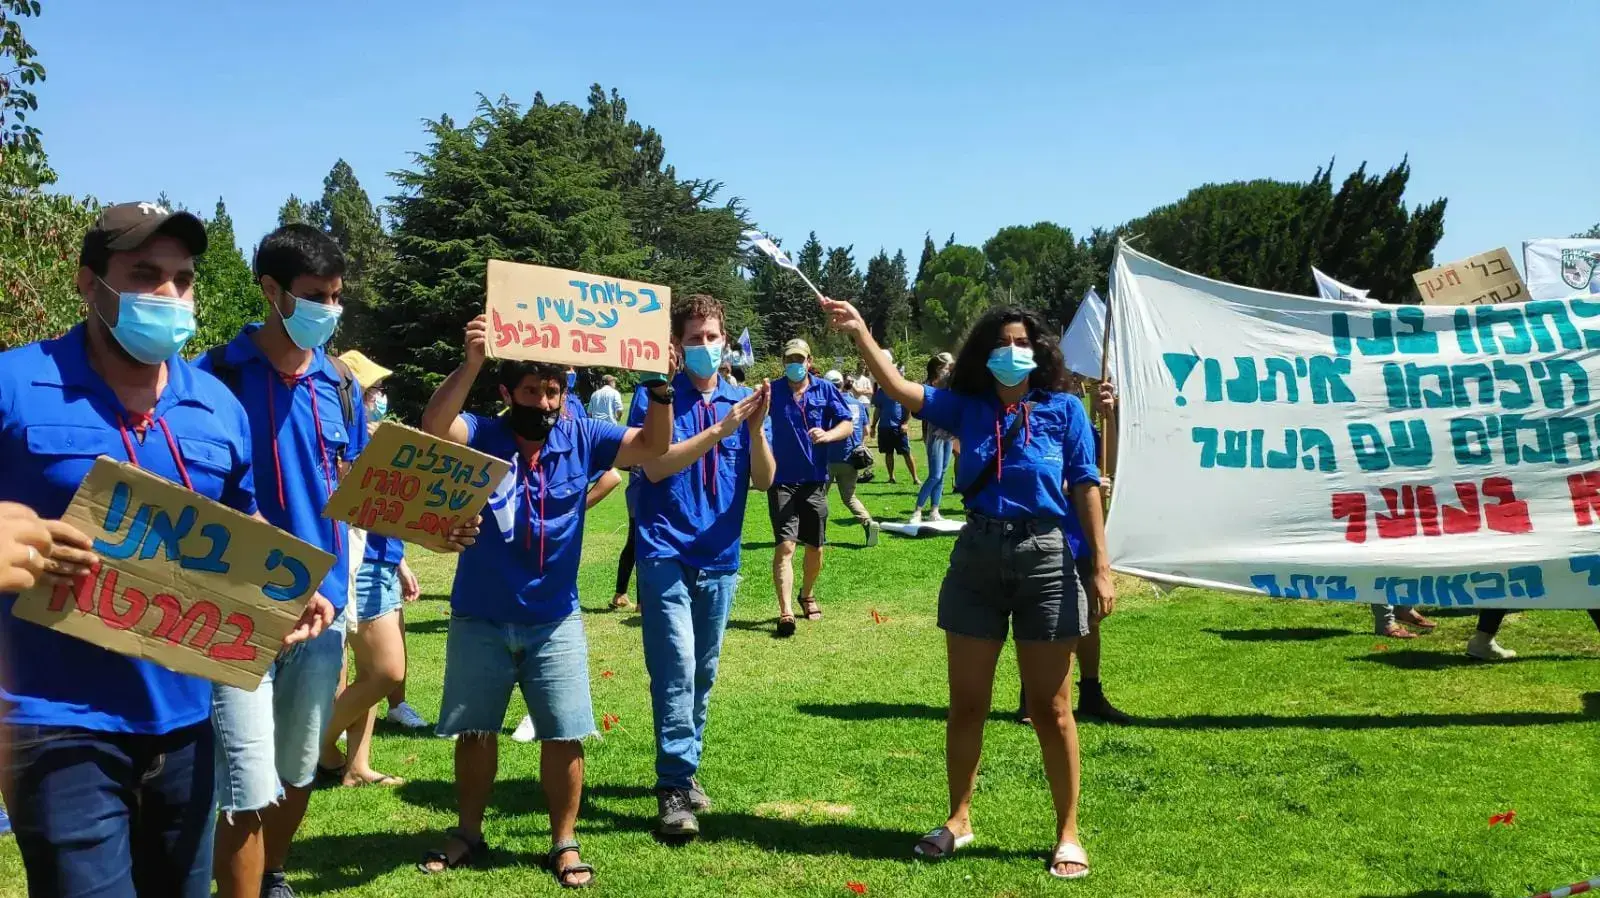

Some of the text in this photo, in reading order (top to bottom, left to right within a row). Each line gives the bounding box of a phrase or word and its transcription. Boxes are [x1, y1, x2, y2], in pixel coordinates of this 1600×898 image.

[1418, 258, 1512, 299] בלי חינוך
[492, 307, 561, 349] הבית!
[536, 296, 619, 329] עכשיו
[1331, 307, 1438, 356] בנו
[620, 338, 660, 369] הקן
[1162, 352, 1590, 409] תילחמו איתנו!
[1191, 413, 1600, 472] חמים עם הנוער
[360, 467, 475, 511] שלי סגרו
[1331, 476, 1533, 543] בנוער
[261, 549, 311, 601] כי
